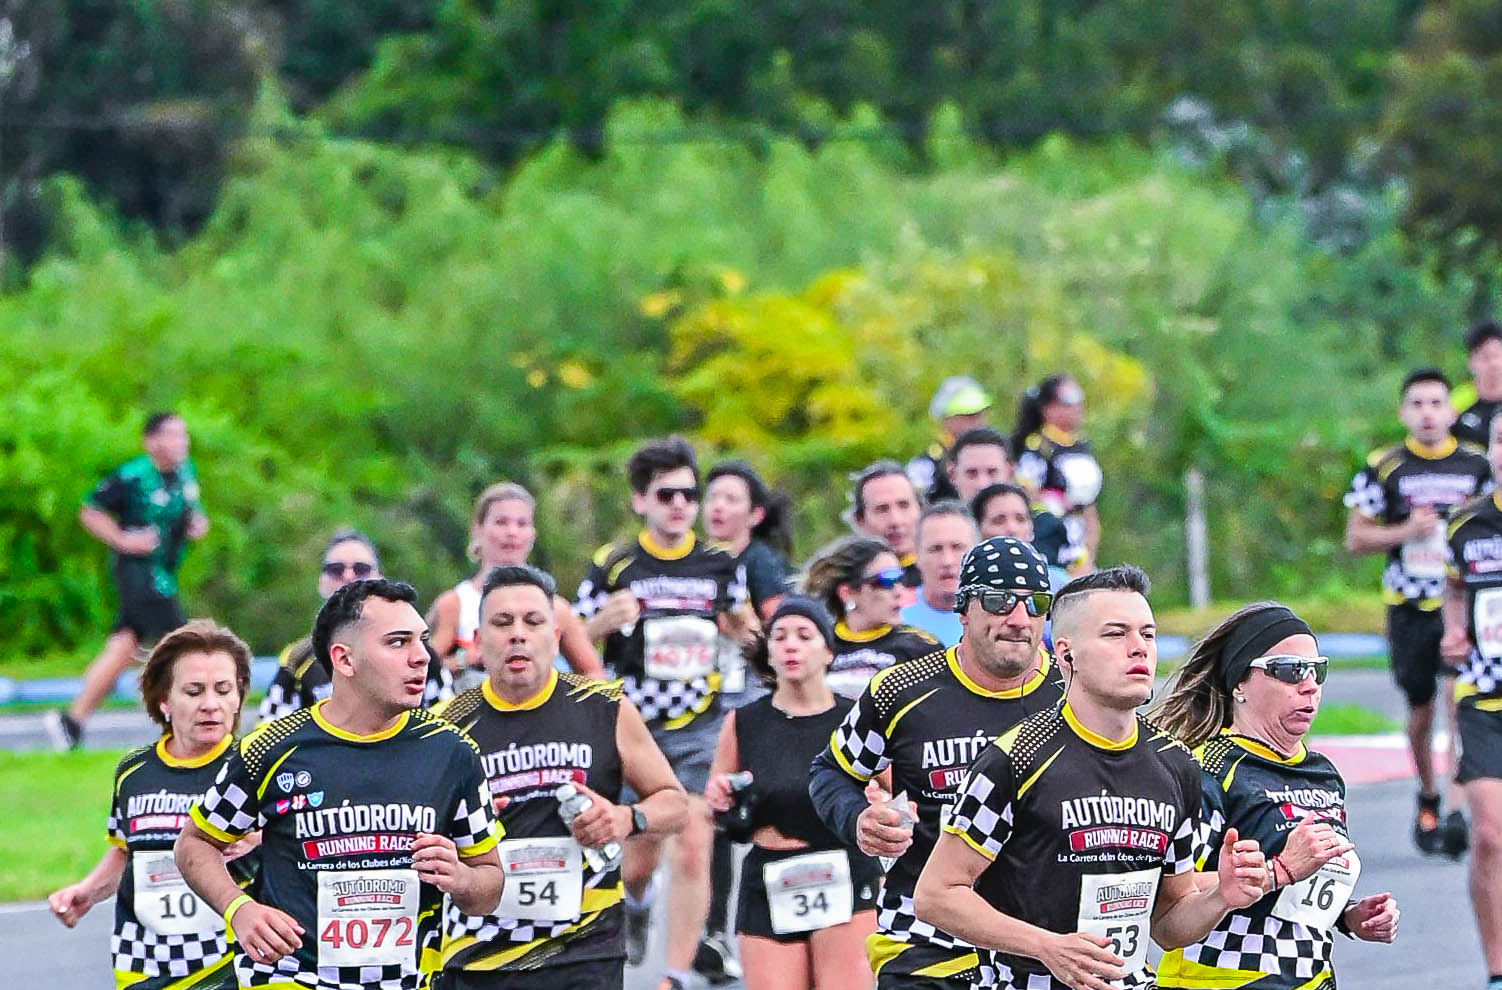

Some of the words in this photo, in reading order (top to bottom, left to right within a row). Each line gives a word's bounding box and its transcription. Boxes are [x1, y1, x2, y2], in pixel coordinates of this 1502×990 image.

[480, 742, 593, 779] UTÓDROMO
[295, 799, 437, 839] AUTÓDROMO
[1061, 789, 1176, 833] AUTÓDROMO
[316, 835, 377, 857] RUNNING
[379, 834, 413, 851] RACE
[1084, 830, 1128, 849] RUNNING
[1130, 830, 1161, 850] RACE
[306, 862, 335, 870] Carrera
[335, 861, 347, 869] de
[347, 860, 360, 869] los
[361, 859, 388, 868] Clubes
[1057, 854, 1068, 863] La
[1069, 853, 1098, 863] Carrera
[332, 876, 407, 897] AUTÓDROMO
[518, 880, 559, 906] 54
[1301, 876, 1336, 911] 16
[160, 892, 197, 919] 10
[793, 892, 829, 917] 34
[320, 917, 414, 949] 4072
[1106, 924, 1140, 958] 53
